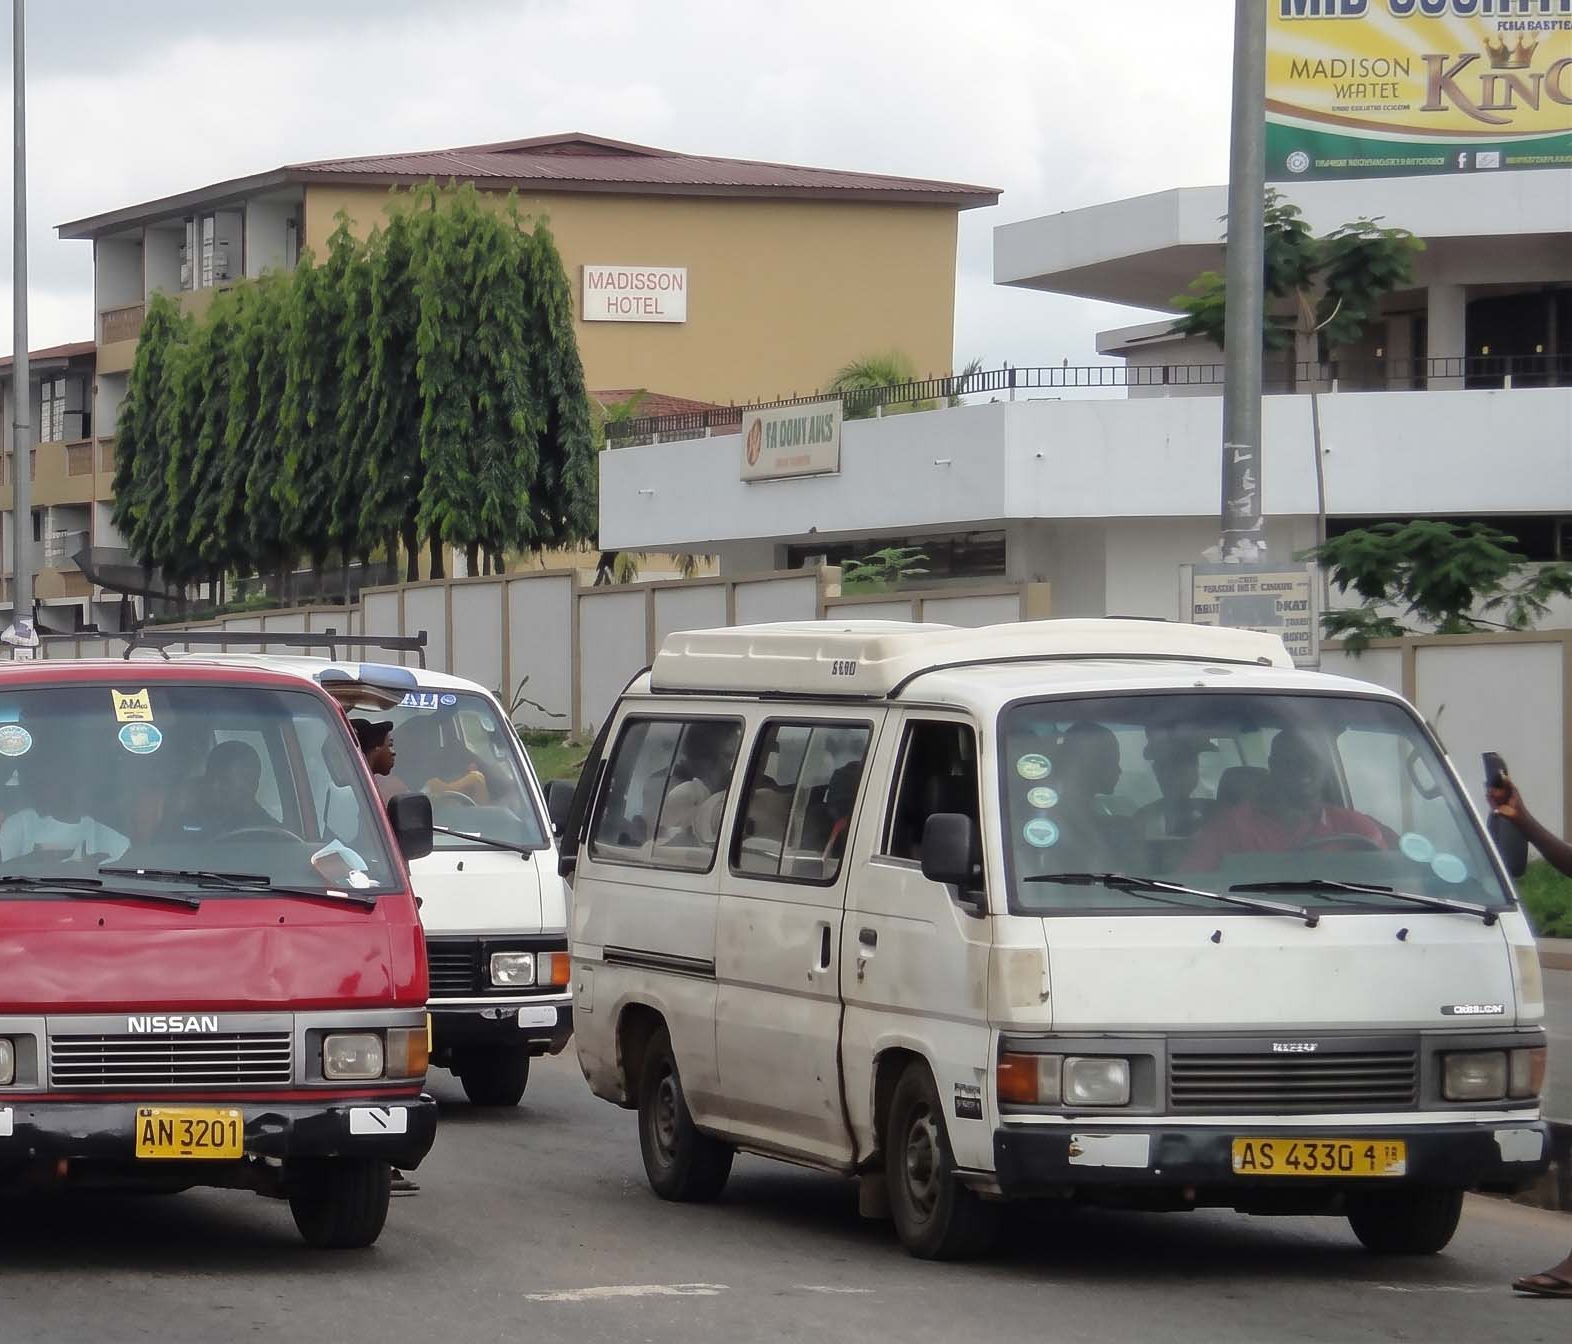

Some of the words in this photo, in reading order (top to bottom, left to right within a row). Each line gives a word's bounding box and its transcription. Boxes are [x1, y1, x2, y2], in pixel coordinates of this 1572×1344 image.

[1290, 57, 1410, 79] MADISON
[588, 271, 683, 291] MADISSON
[607, 296, 664, 314] HOTEL
[128, 1015, 218, 1033] NISSAN
[142, 1119, 174, 1147] AN
[179, 1119, 237, 1148] 3201
[1241, 1142, 1275, 1170] AS
